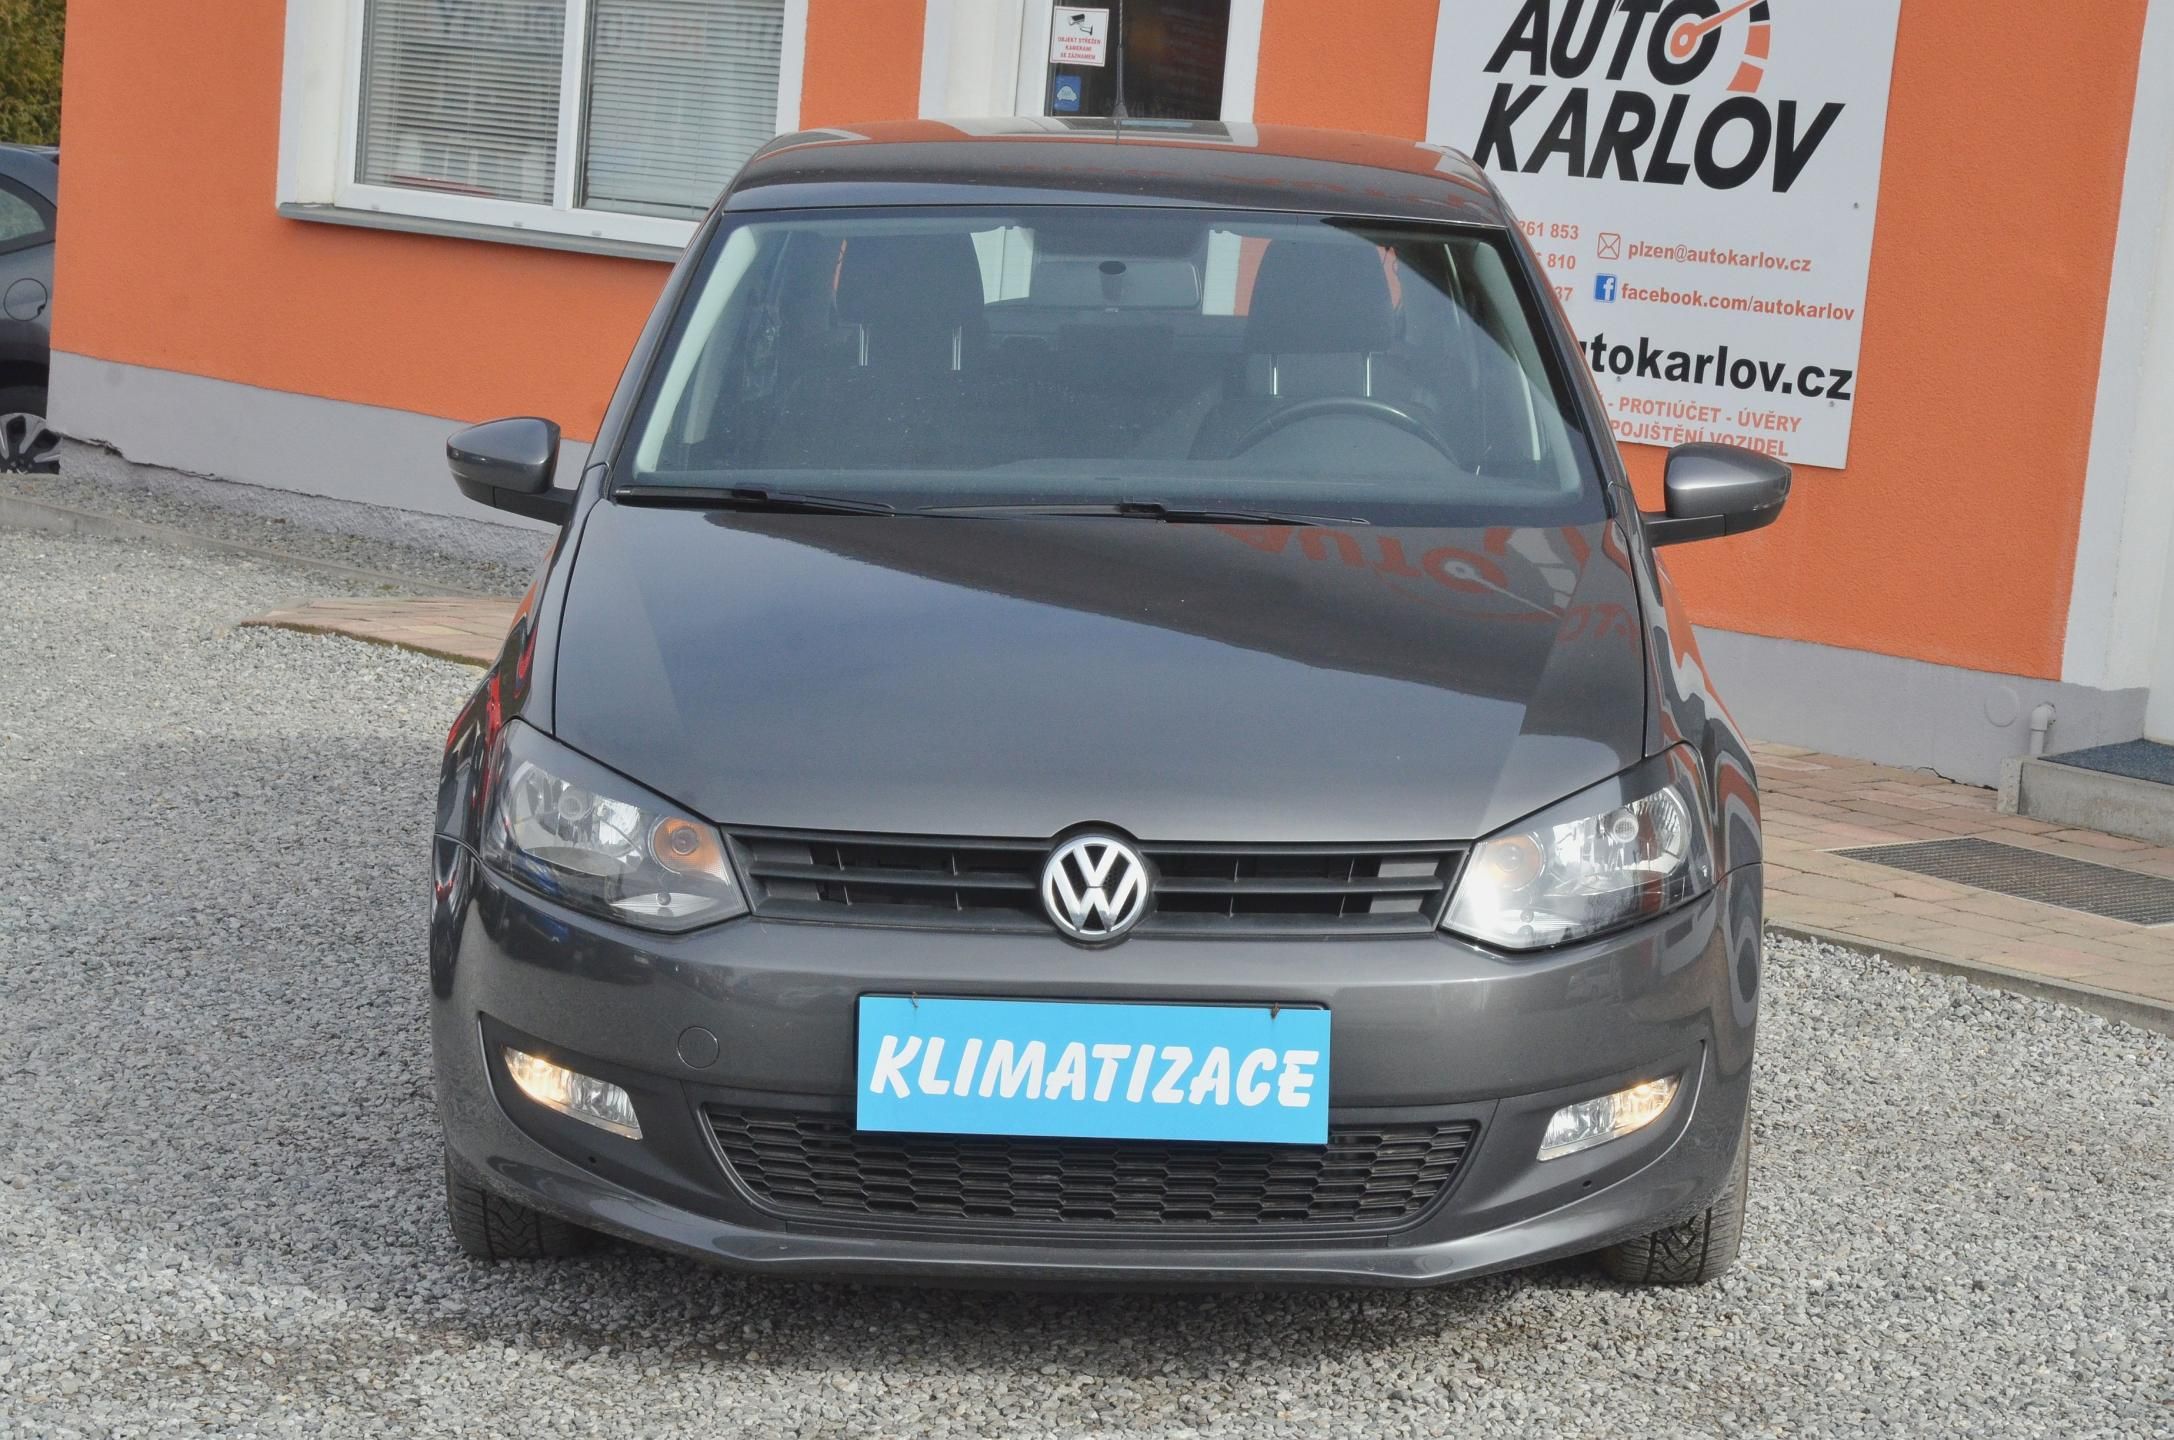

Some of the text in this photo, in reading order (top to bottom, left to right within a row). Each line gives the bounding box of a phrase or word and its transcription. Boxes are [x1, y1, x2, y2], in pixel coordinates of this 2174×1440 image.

[1483, 0, 1722, 85] AUTO
[1472, 82, 1846, 194] KARLOV
[1550, 223, 1579, 240] 853
[1547, 253, 1576, 270] 810
[1627, 240, 1812, 272] plzen@autokarlov.cz
[1620, 283, 1855, 321] facebook.com/autokarlov
[1619, 396, 1722, 423] PROTIÚČET
[1737, 407, 1802, 433] ÚVĚRY
[869, 1034, 1320, 1108] KLIMATIZACE
